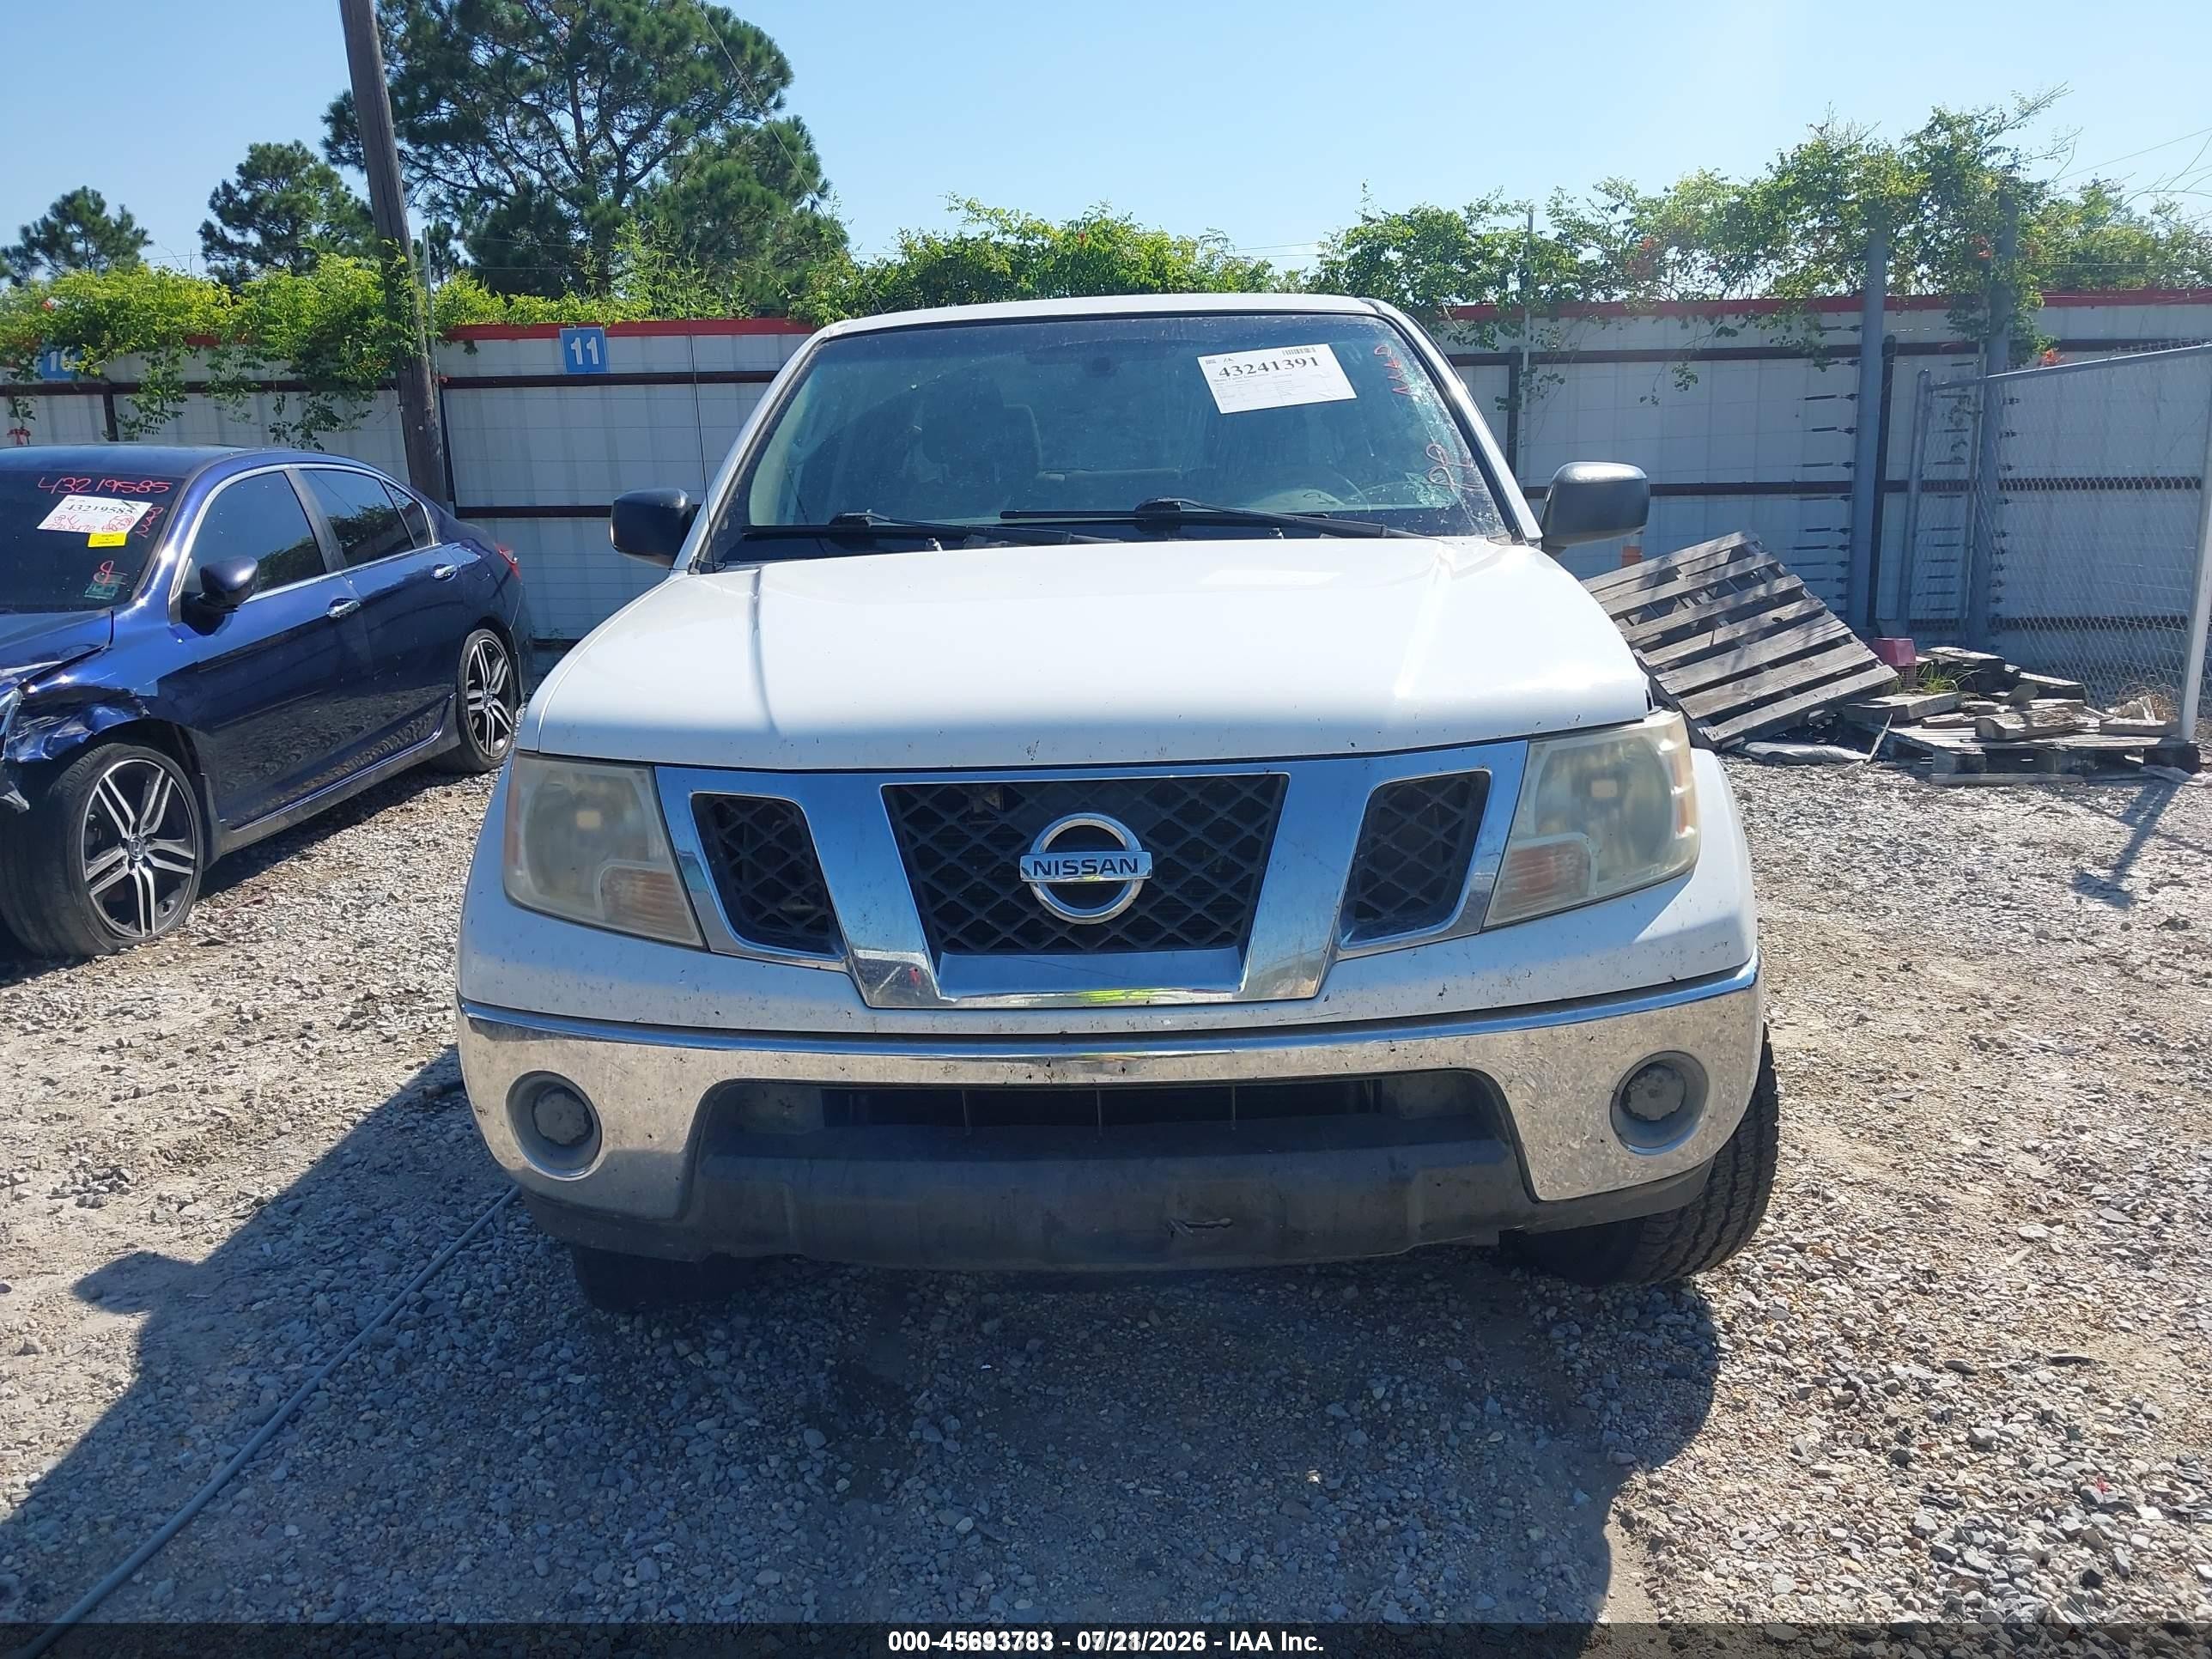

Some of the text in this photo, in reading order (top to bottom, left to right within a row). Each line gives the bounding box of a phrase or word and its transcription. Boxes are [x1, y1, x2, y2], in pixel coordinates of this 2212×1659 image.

[570, 337, 599, 365] 11
[1218, 356, 1320, 378] 43241391
[37, 477, 173, 494] 43219585
[65, 504, 134, 515] 43219585
[1034, 858, 1139, 877] NISSAN
